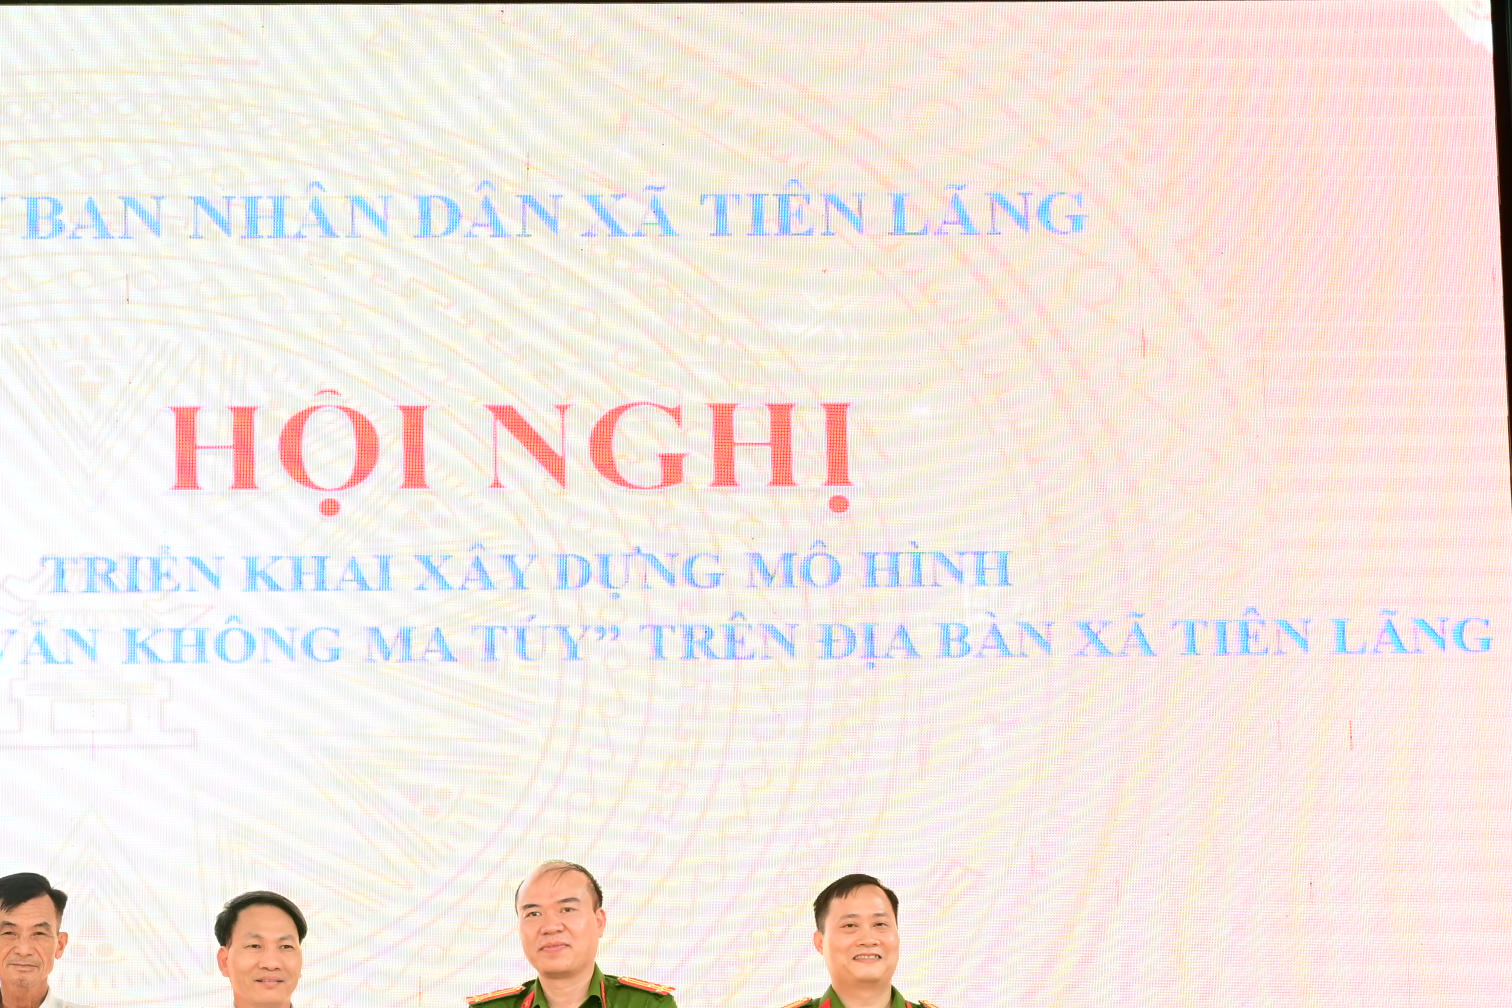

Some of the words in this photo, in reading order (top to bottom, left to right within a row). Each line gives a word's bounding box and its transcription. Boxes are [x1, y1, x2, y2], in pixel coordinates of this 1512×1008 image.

[22, 194, 165, 240] BAN
[188, 181, 392, 240] NHÂN
[414, 179, 563, 239] DÂN
[582, 183, 680, 238] XÃ
[700, 178, 867, 237] TIÊN
[890, 184, 1088, 236] LÃNG
[170, 389, 430, 517] HỘI
[484, 401, 854, 514] NGHỊ
[40, 543, 224, 595] TRIỂN
[241, 554, 394, 593] KHAI
[414, 541, 539, 592] XÂY
[554, 545, 724, 599] DỰNG
[746, 541, 843, 590] MÔ
[861, 541, 1013, 588] HÌNH
[121, 615, 345, 665] KHÔNG
[364, 625, 458, 664] MA
[472, 614, 622, 663] TÚY”
[638, 613, 798, 662] TRÊN
[818, 622, 922, 669] ĐỊA
[934, 612, 1054, 659] BÀN
[1073, 611, 1158, 657] XÃ
[1171, 607, 1312, 656] TIÊN
[1330, 609, 1494, 655] LÃNG
